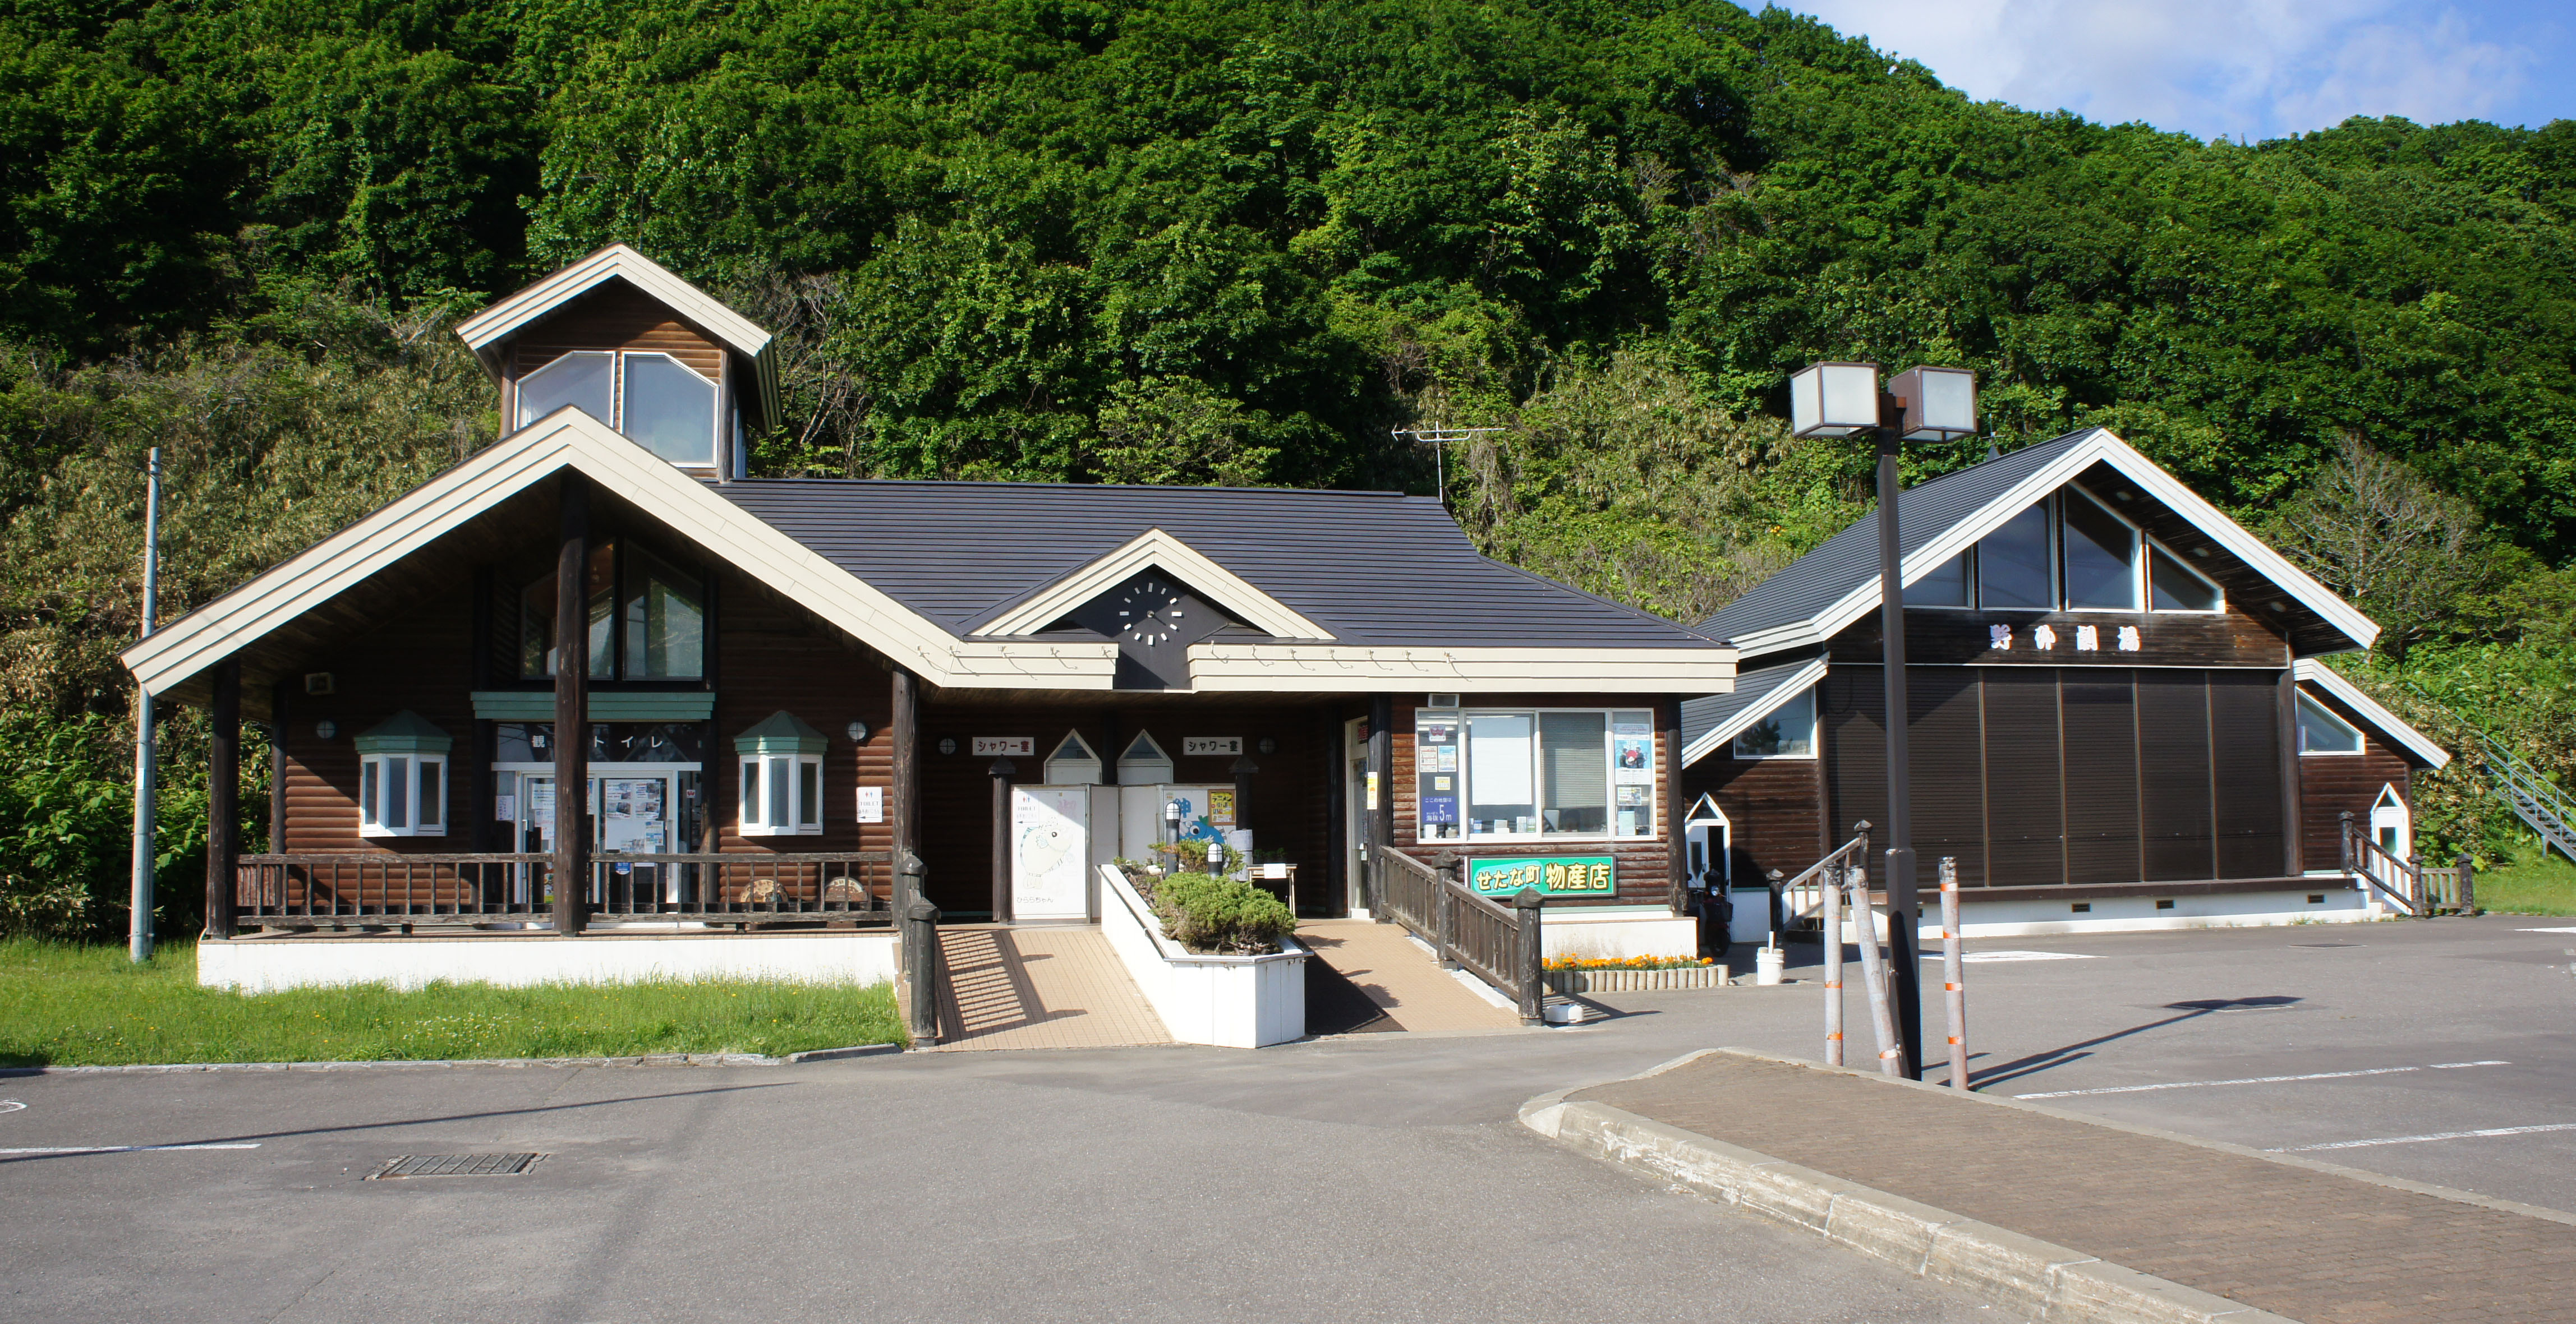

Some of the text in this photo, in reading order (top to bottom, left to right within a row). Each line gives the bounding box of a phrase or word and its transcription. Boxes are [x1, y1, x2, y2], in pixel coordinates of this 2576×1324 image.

[532, 735, 663, 748] 観トイレ
[978, 740, 1029, 752] シャワー室
[1189, 740, 1238, 752] シャワー室
[1476, 862, 1611, 891] せたな町 物産店
